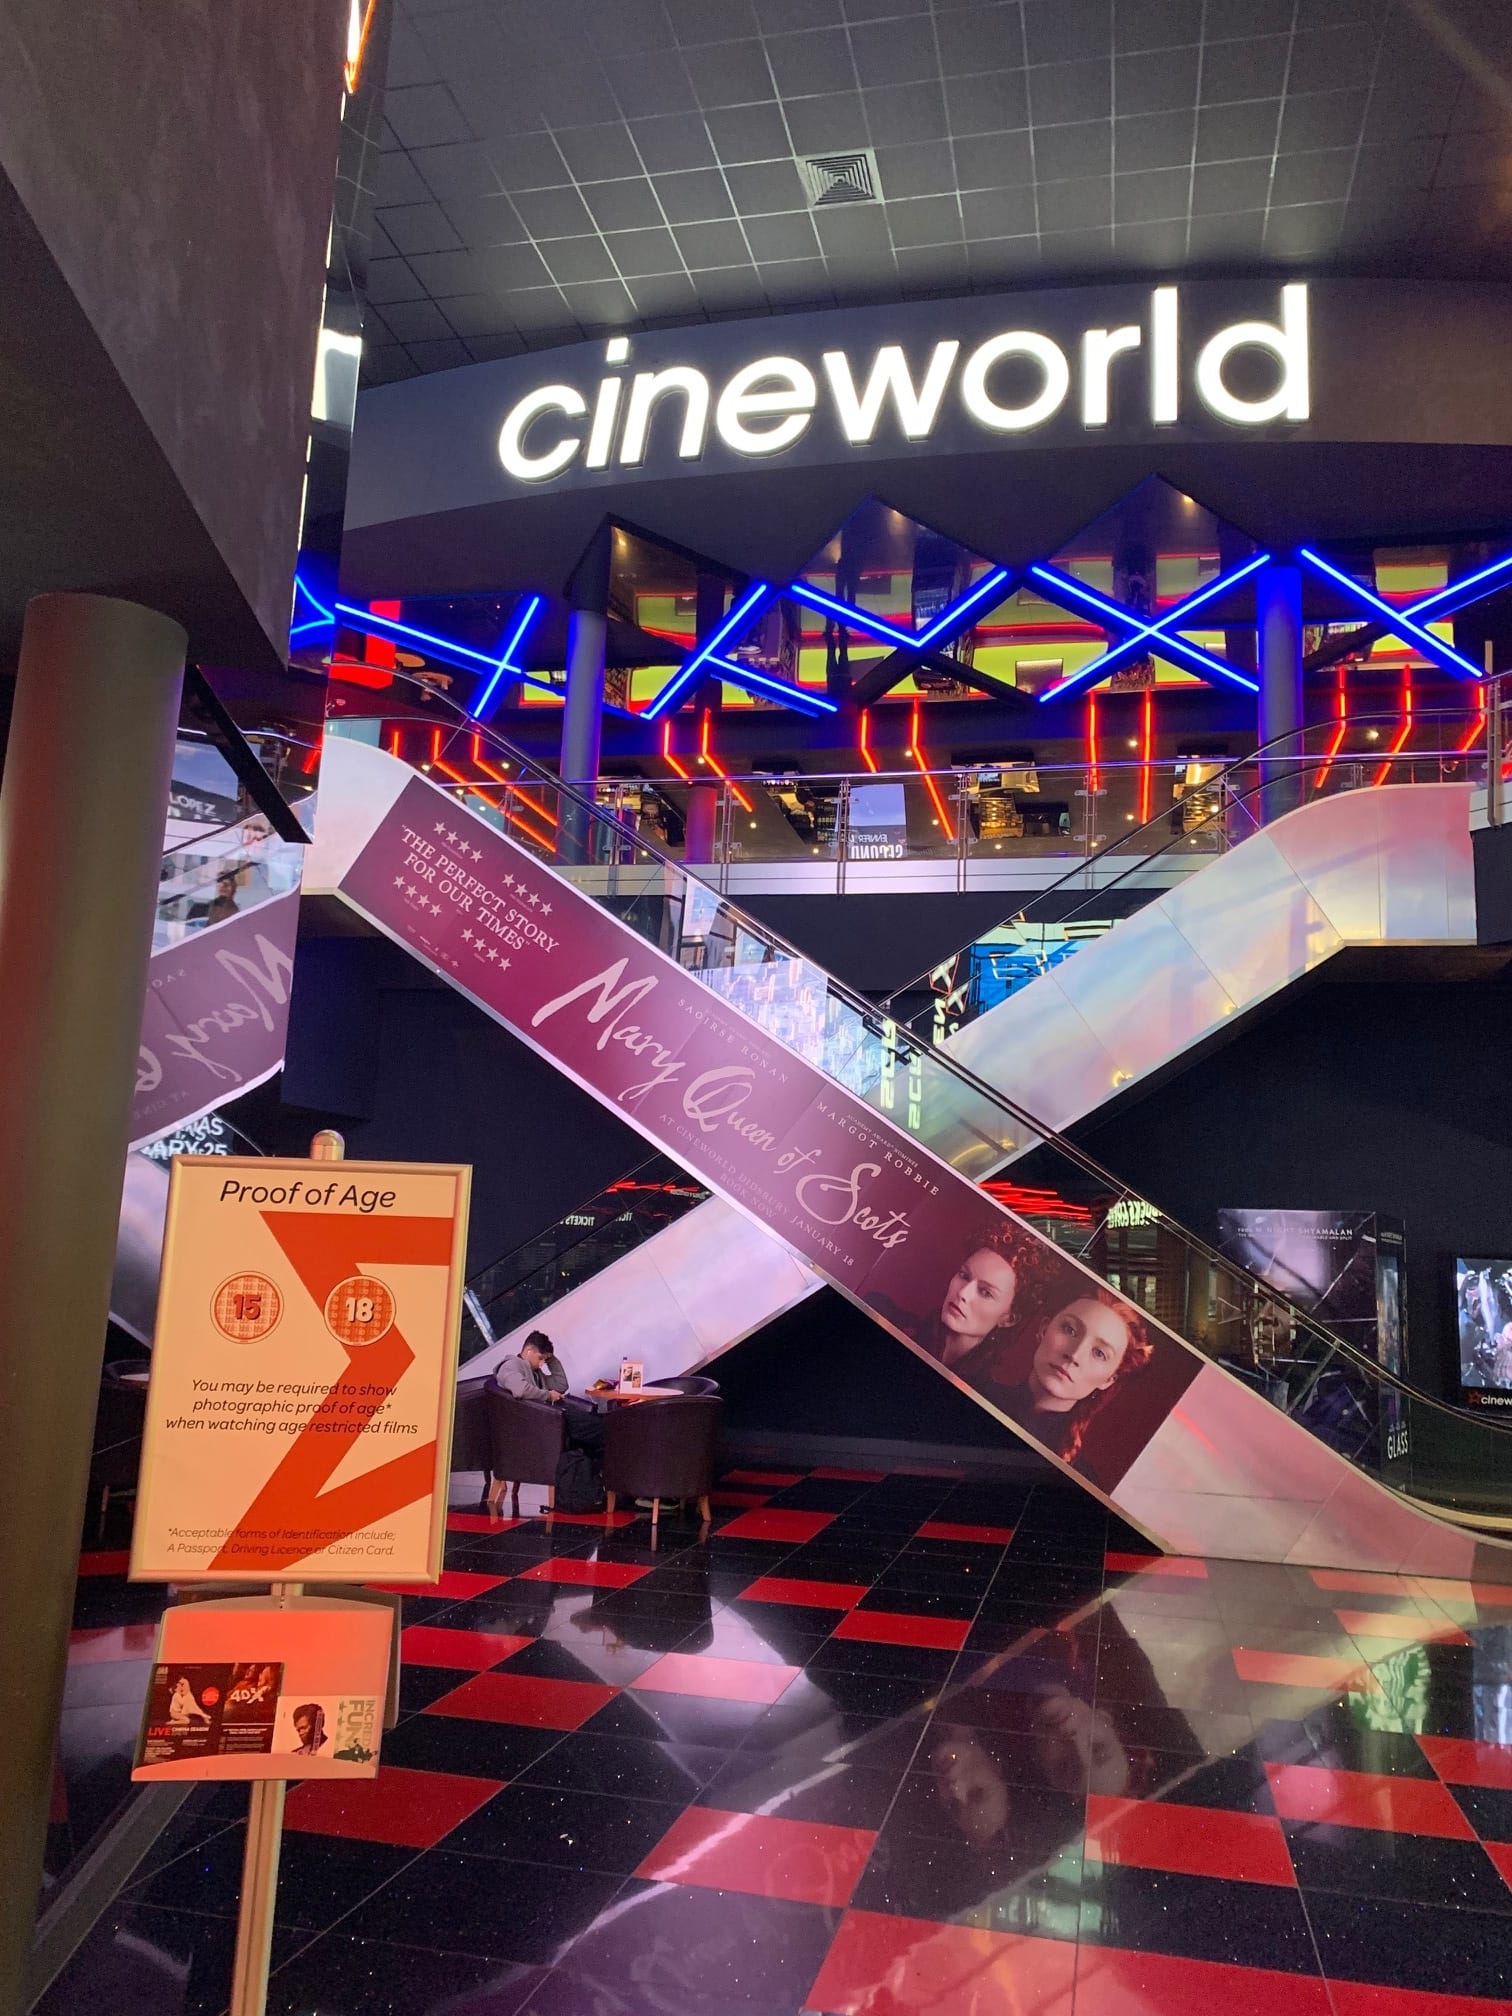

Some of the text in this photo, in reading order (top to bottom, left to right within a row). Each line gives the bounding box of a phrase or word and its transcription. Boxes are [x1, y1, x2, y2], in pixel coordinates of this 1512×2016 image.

[496, 282, 1312, 483] cineworld
[403, 852, 437, 884] FOR
[438, 879, 474, 913] OUR
[435, 854, 506, 913] PERFECT
[504, 908, 560, 954] STORY
[531, 957, 686, 1101] Mary
[678, 998, 734, 1044] SAOIRSE
[740, 1045, 789, 1084] RONAN
[682, 1065, 777, 1152] Queen
[773, 1146, 822, 1174] of
[816, 1101, 940, 1197] MARGOT ROBBIE
[219, 1180, 396, 1213] Proof of Age
[659, 1113, 675, 1127] AT
[790, 1215, 842, 1255] JANUARY
[842, 1254, 855, 1267] 18
[795, 1162, 911, 1248] Scots
[233, 1294, 375, 1323] 15 18
[192, 1379, 397, 1396] You may be required to show
[193, 1399, 293, 1414] photographic
[295, 1401, 338, 1416] proof
[339, 1401, 355, 1415] of
[166, 1417, 418, 1435] when watching age restricted films
[1387, 1431, 1409, 1460] GLASS
[235, 1528, 267, 1539] forms
[269, 1529, 281, 1539] of
[281, 1529, 352, 1540] Identification
[167, 1543, 175, 1553] A
[231, 1544, 269, 1557] Driving
[271, 1544, 315, 1555] Licence
[327, 1544, 364, 1555] Citizen
[366, 1545, 395, 1556] Card.
[230, 1686, 272, 1704] 4DX
[148, 1727, 171, 1736] LIVE
